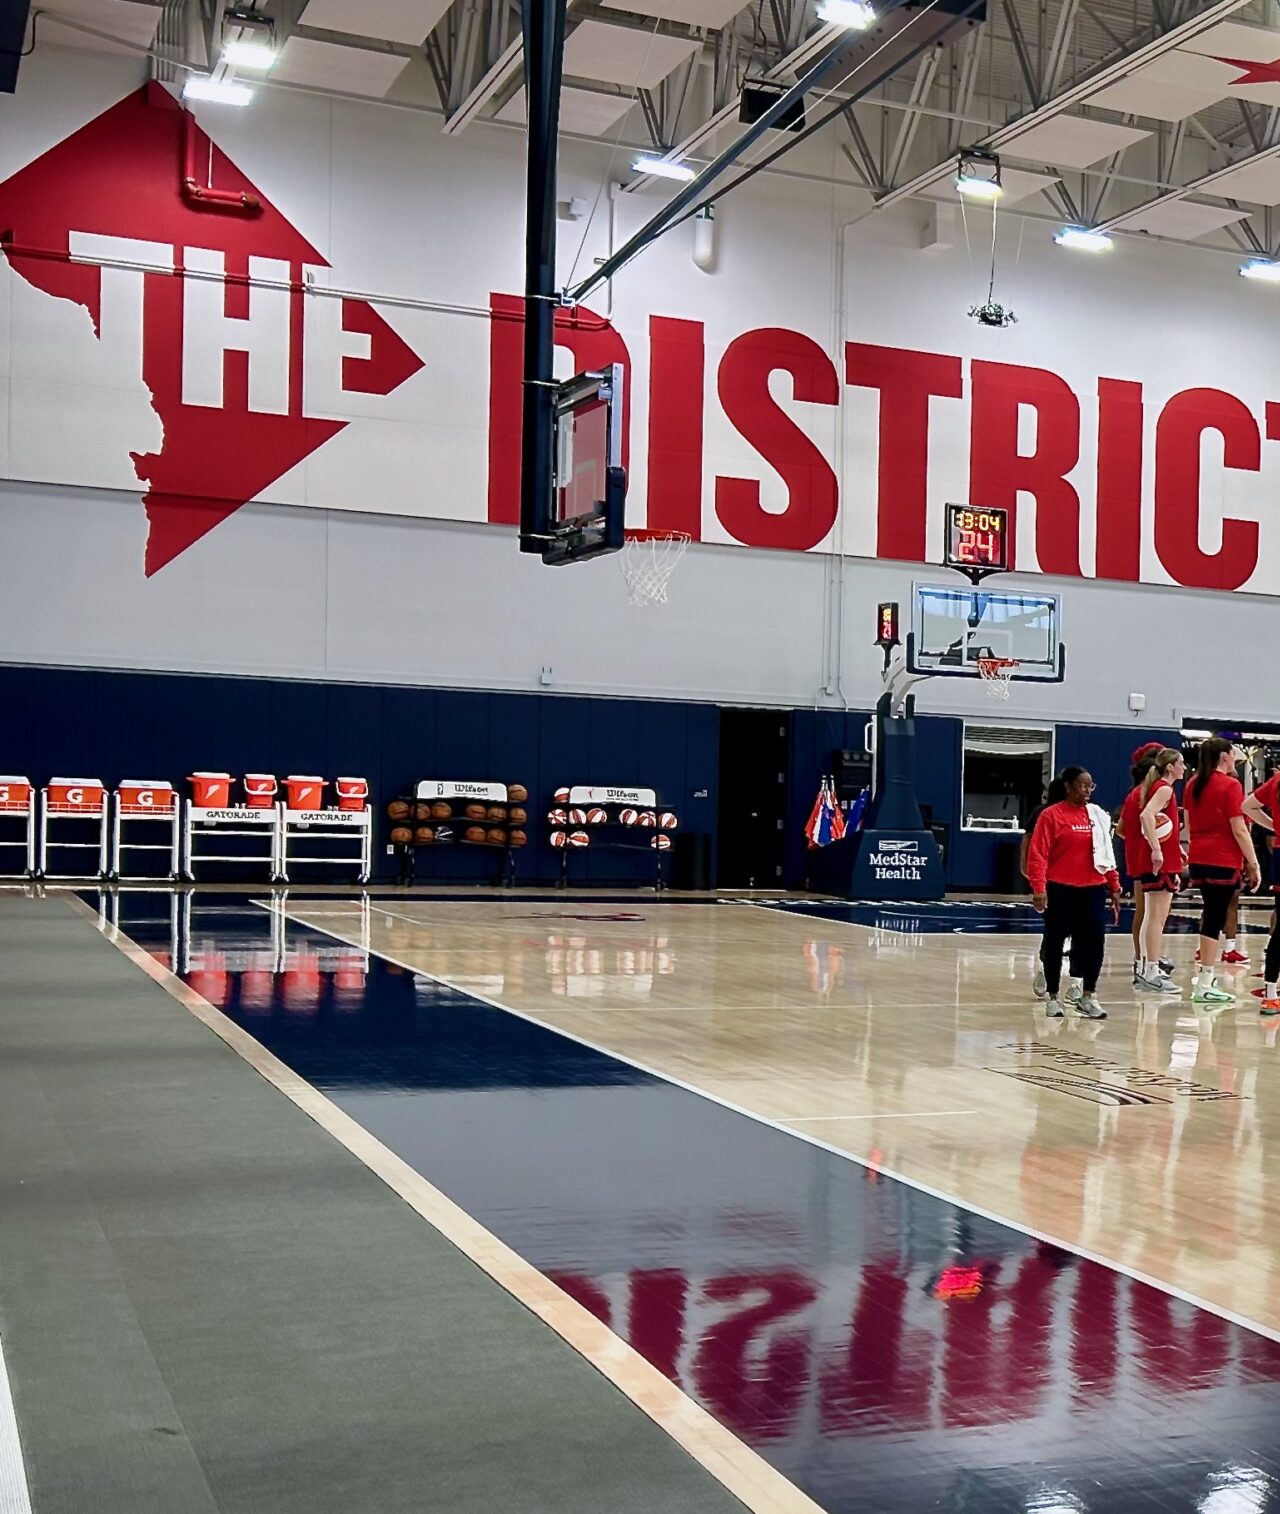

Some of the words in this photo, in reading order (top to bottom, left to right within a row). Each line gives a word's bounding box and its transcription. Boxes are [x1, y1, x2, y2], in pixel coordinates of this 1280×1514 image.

[69, 230, 375, 420] THE
[959, 530, 994, 561] 24
[66, 788, 83, 803] G
[137, 791, 153, 806] G
[206, 811, 261, 819] GATORADE
[300, 813, 353, 822] GATORADE
[869, 853, 928, 866] MedStar
[875, 867, 921, 880] Health
